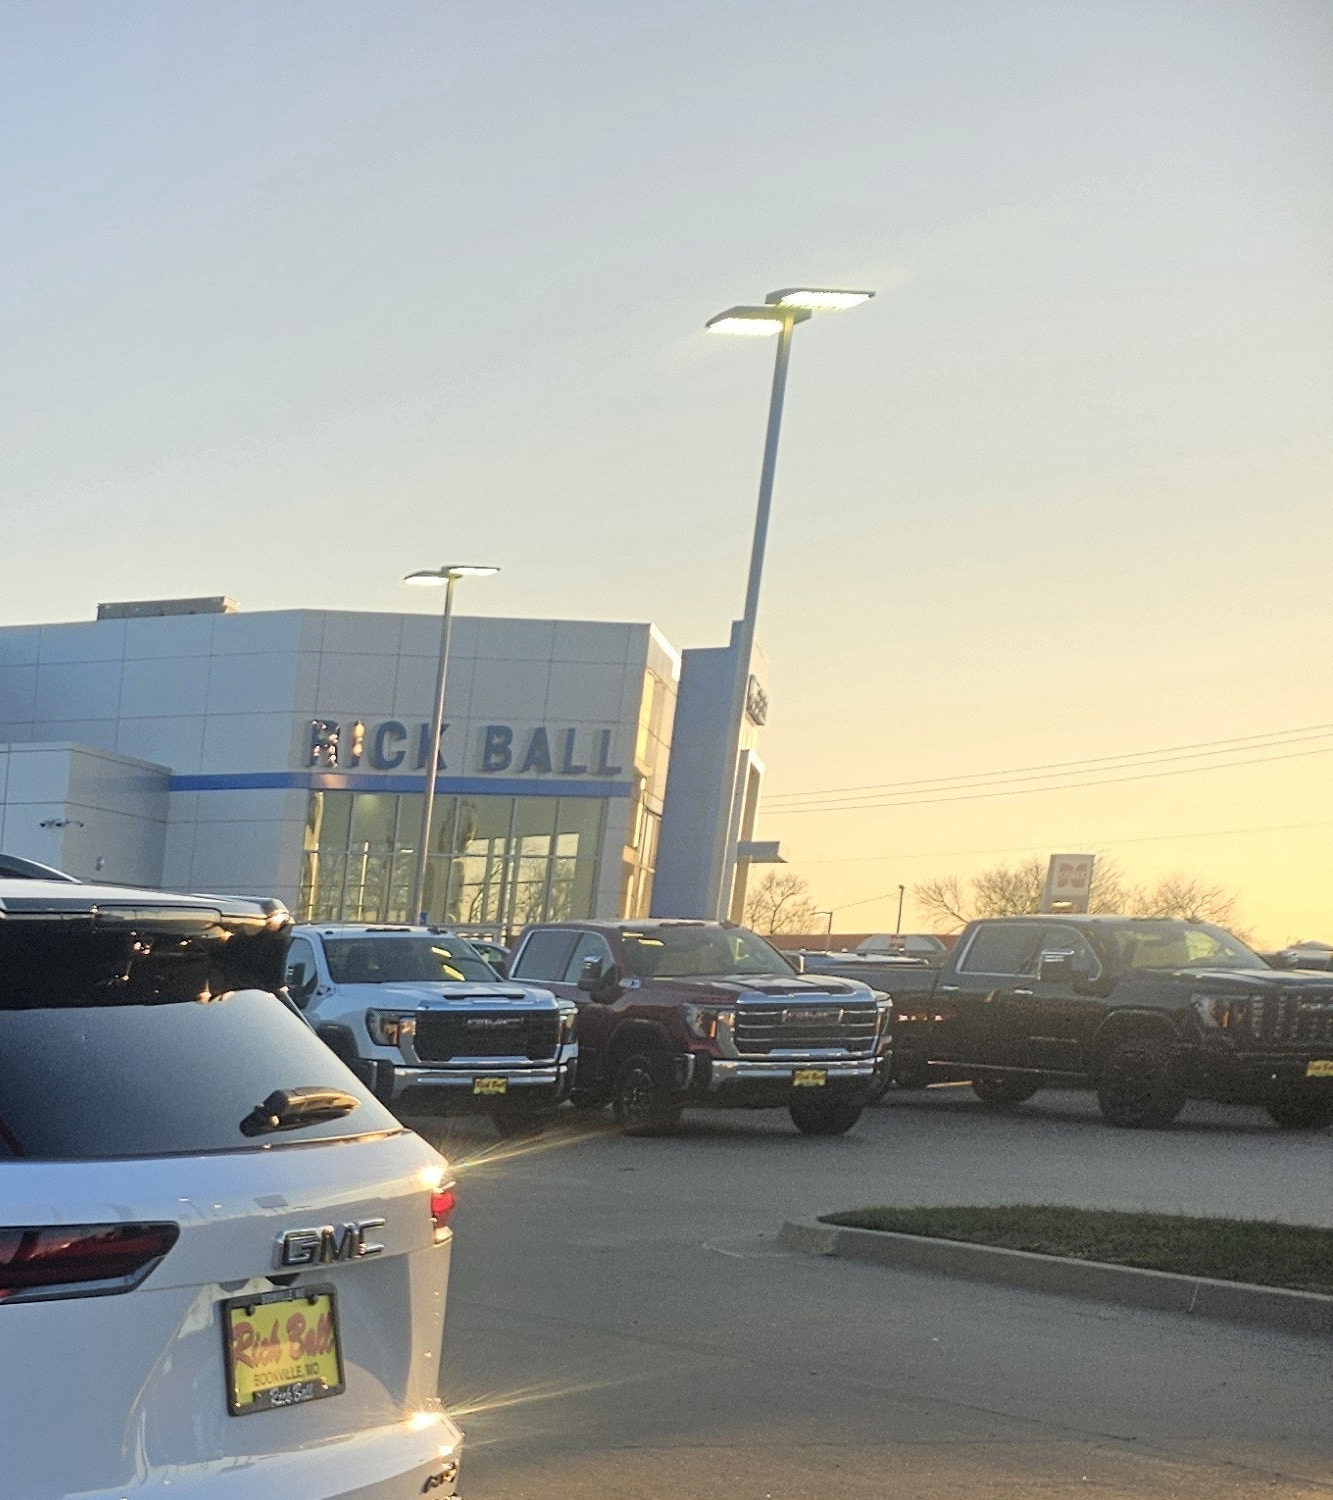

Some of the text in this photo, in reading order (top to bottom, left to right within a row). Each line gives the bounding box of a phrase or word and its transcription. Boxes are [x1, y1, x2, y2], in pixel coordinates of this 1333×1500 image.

[306, 719, 623, 776] RICK BALL
[275, 1218, 386, 1267] GMC
[230, 1311, 334, 1370] Rick Ball
